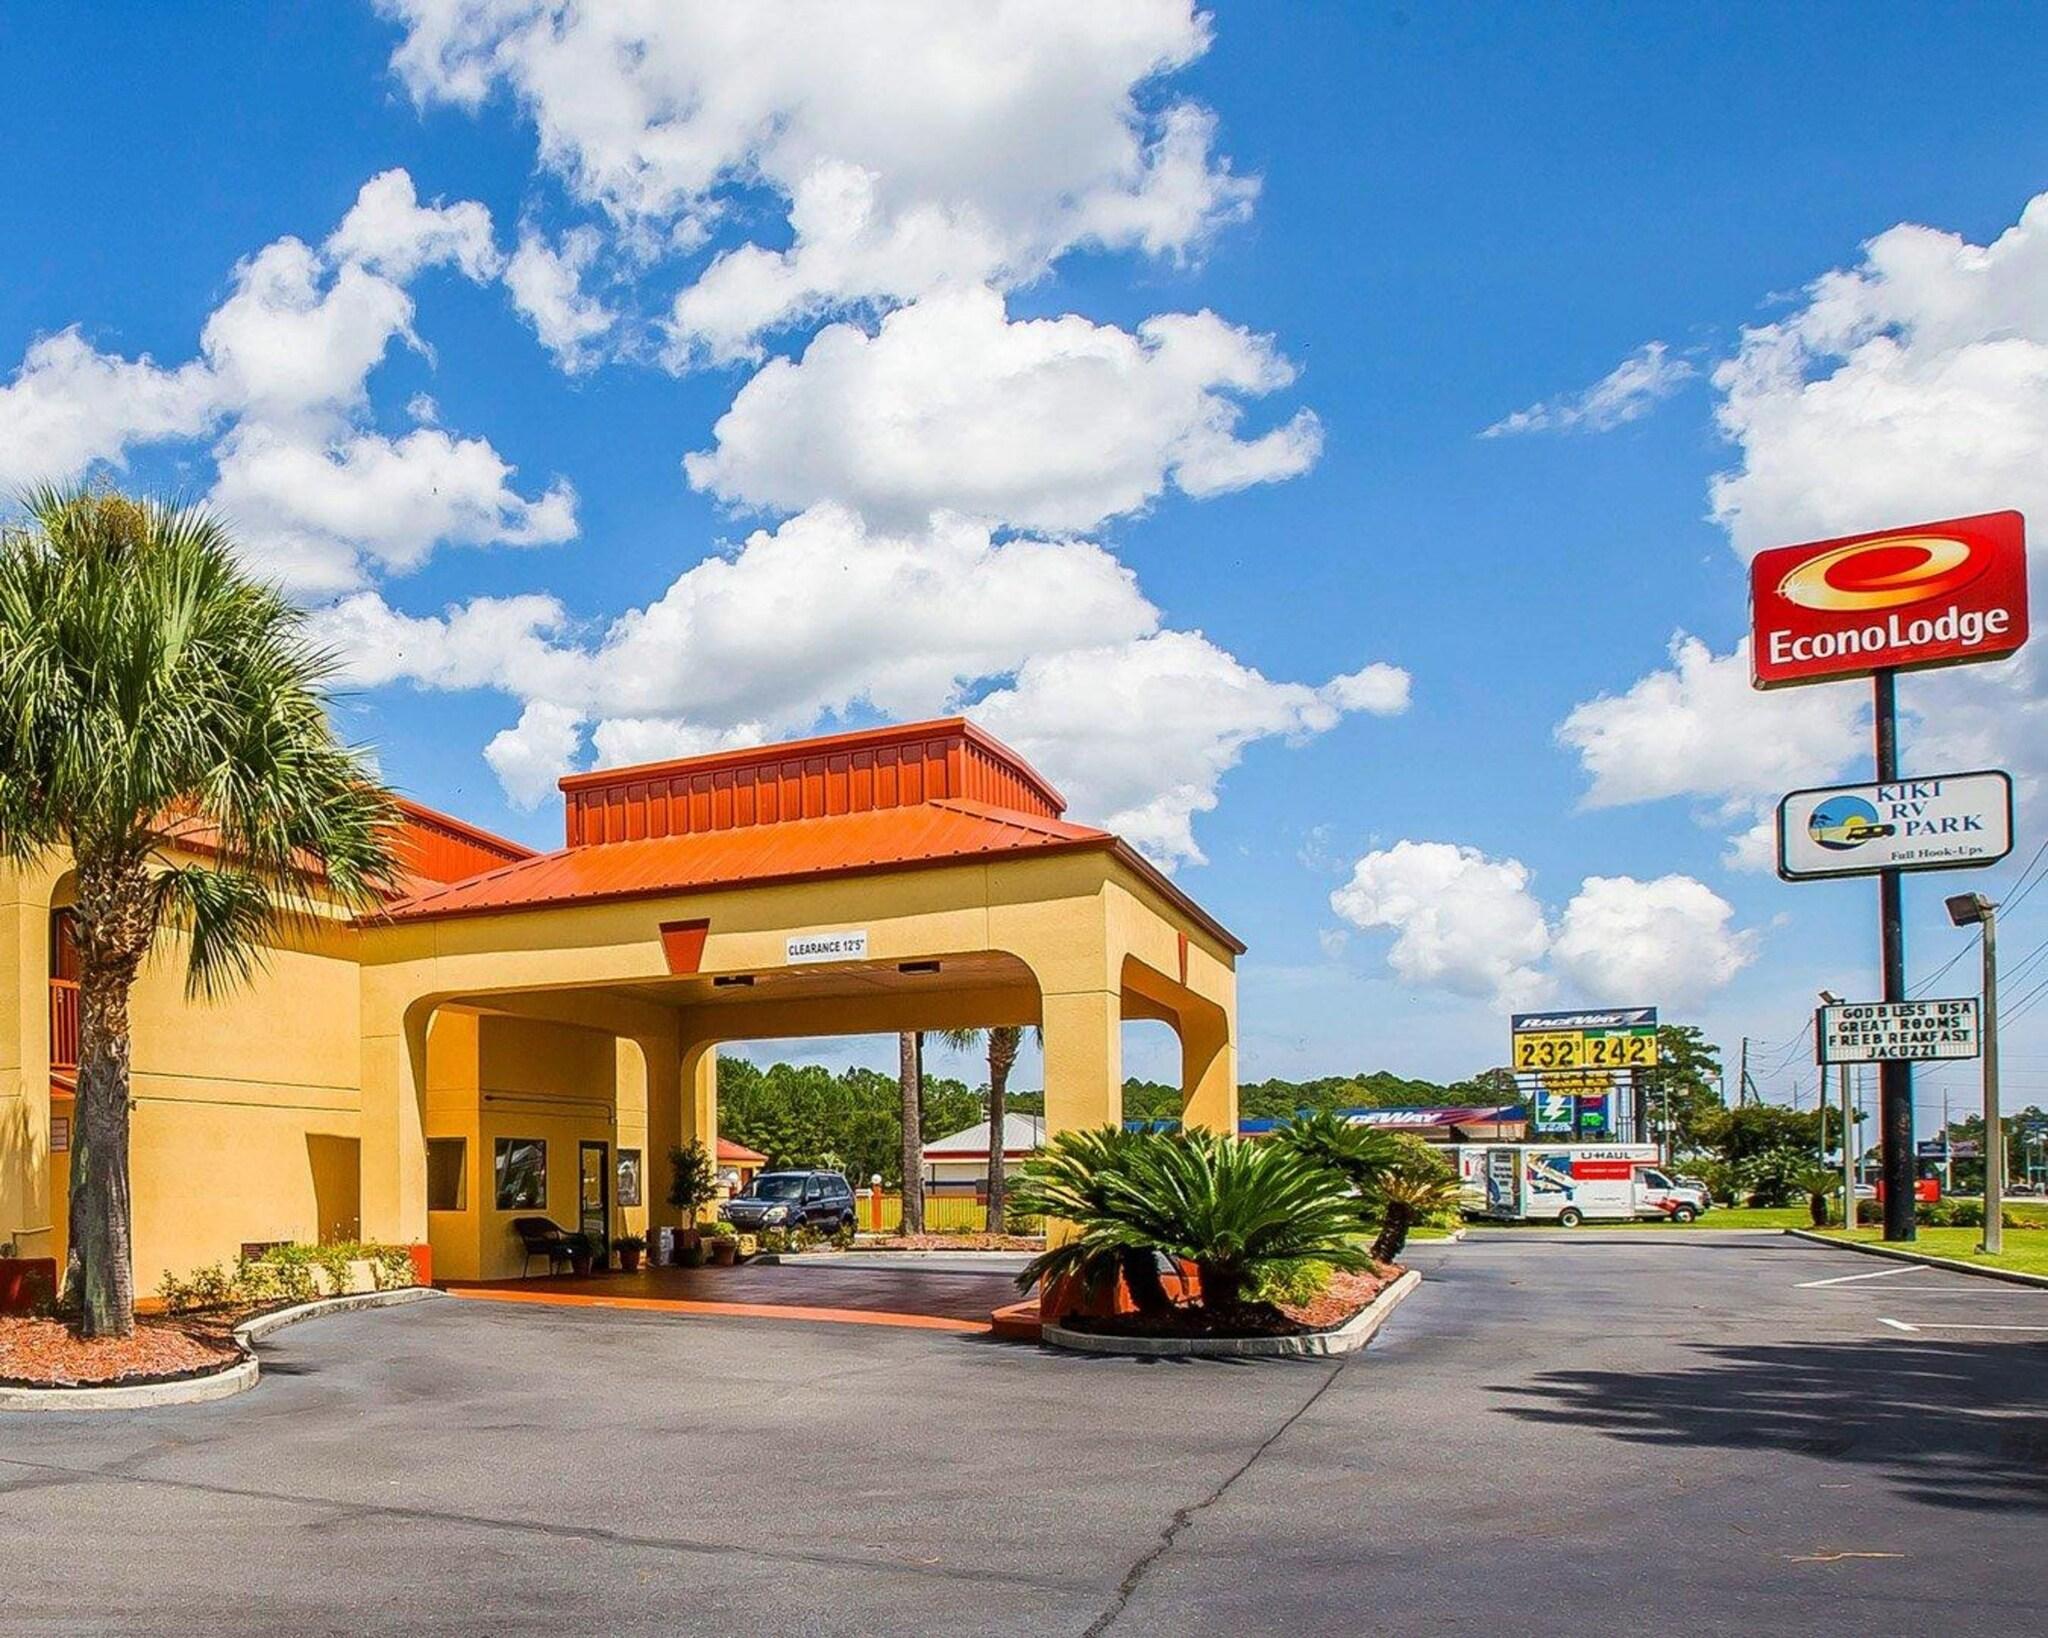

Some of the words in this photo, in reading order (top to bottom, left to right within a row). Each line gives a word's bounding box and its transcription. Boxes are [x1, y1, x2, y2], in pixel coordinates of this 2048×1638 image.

[1770, 605, 2008, 664] EconoLodge
[1877, 780, 1943, 802] KIKI
[1891, 801, 1928, 820] RV
[1906, 814, 1983, 836] PARK
[1891, 848, 1914, 861] Full
[1918, 845, 1984, 859] Hook-Ups
[788, 941, 841, 956] CLEARANCE
[1842, 1007, 1874, 1020] GOD
[1877, 1005, 1926, 1018] BLESS
[1938, 1003, 1972, 1015] USA
[1838, 1019, 1891, 1033] GREAT
[1900, 1016, 1961, 1030] ROOMS
[1867, 1045, 1936, 1058] JACUZZI
[1581, 1151, 1631, 1160] U-HAUL
